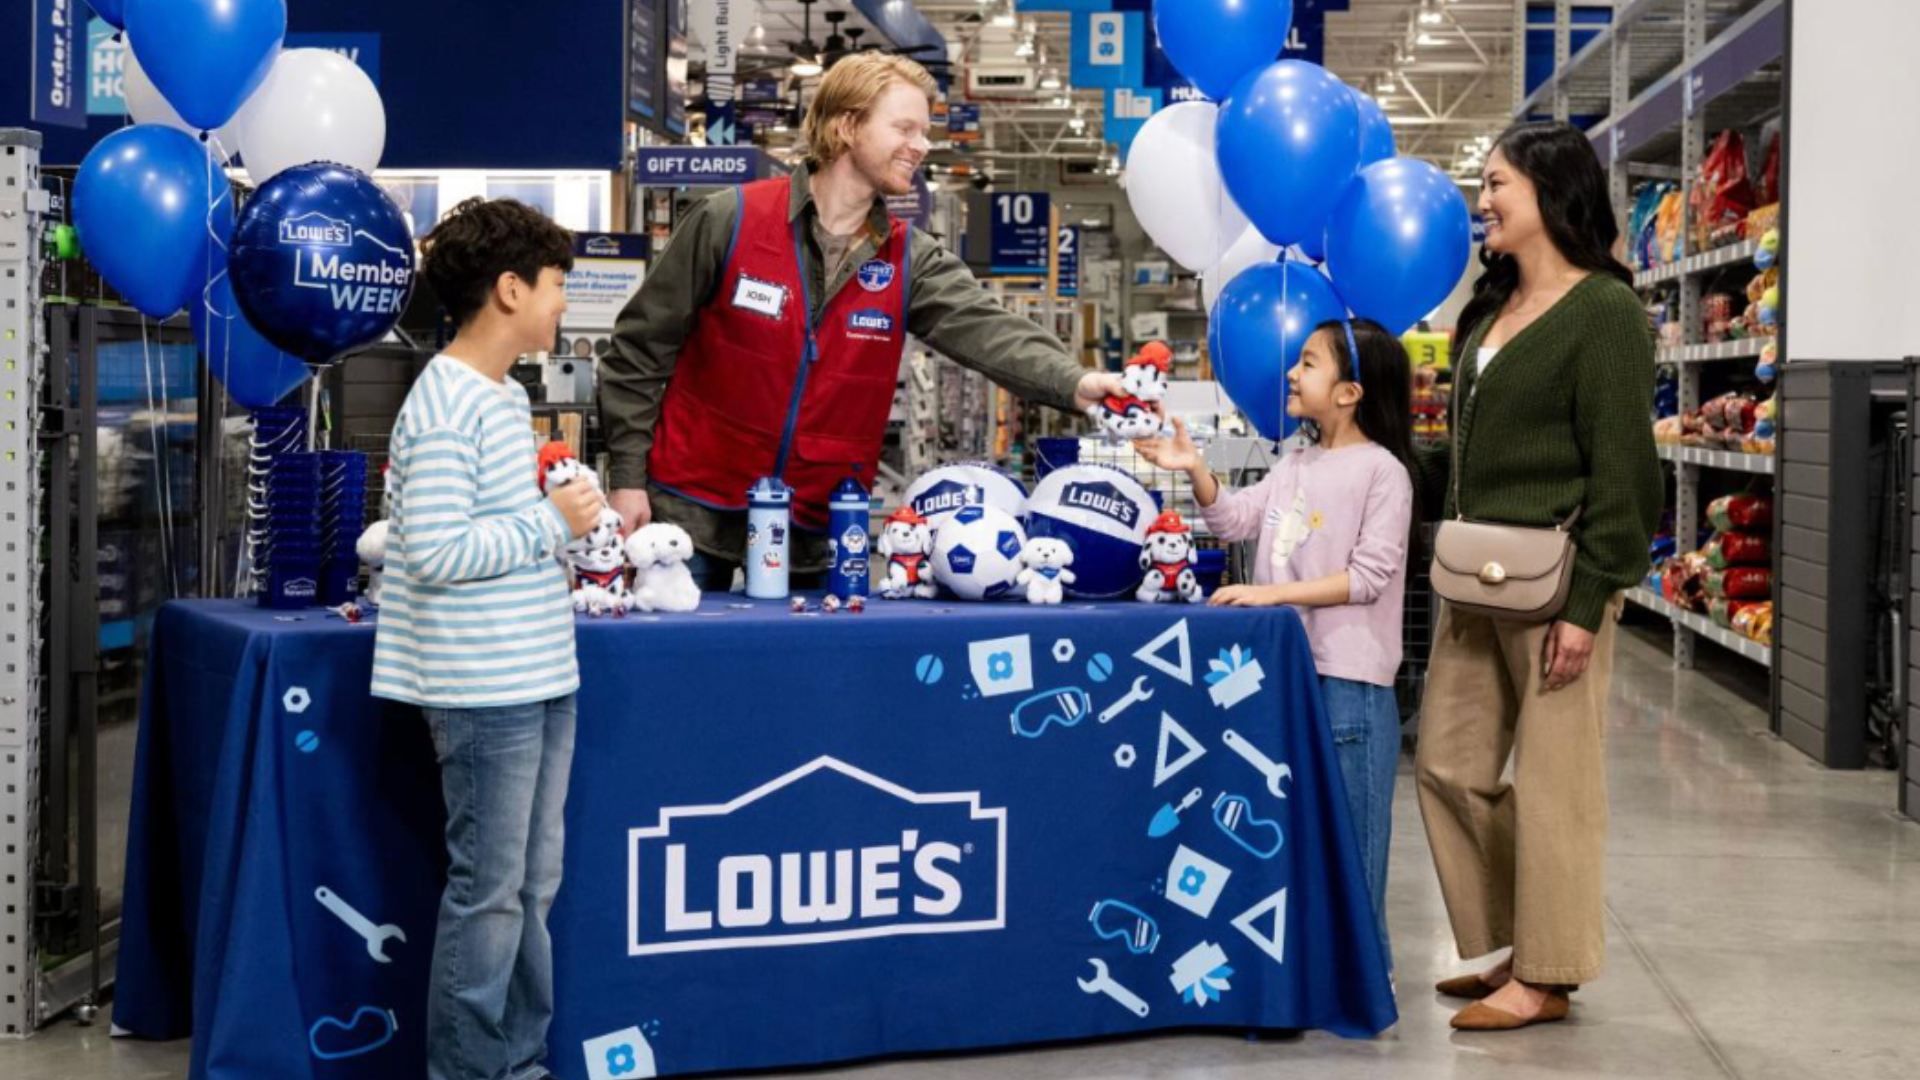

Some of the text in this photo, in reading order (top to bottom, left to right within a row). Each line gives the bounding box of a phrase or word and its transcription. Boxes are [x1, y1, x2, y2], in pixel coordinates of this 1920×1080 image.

[714, 0, 731, 67] Light Bul
[51, 33, 64, 106] Order
[647, 157, 747, 173] GIFT CARDS
[997, 194, 1033, 224] 10
[287, 223, 345, 243] LOWE'S
[311, 252, 412, 285] Member
[330, 283, 406, 314] WEEK
[852, 315, 890, 330] LOWE'S
[1067, 485, 1134, 524] LOWE'S
[664, 829, 963, 932] LOWE'S
